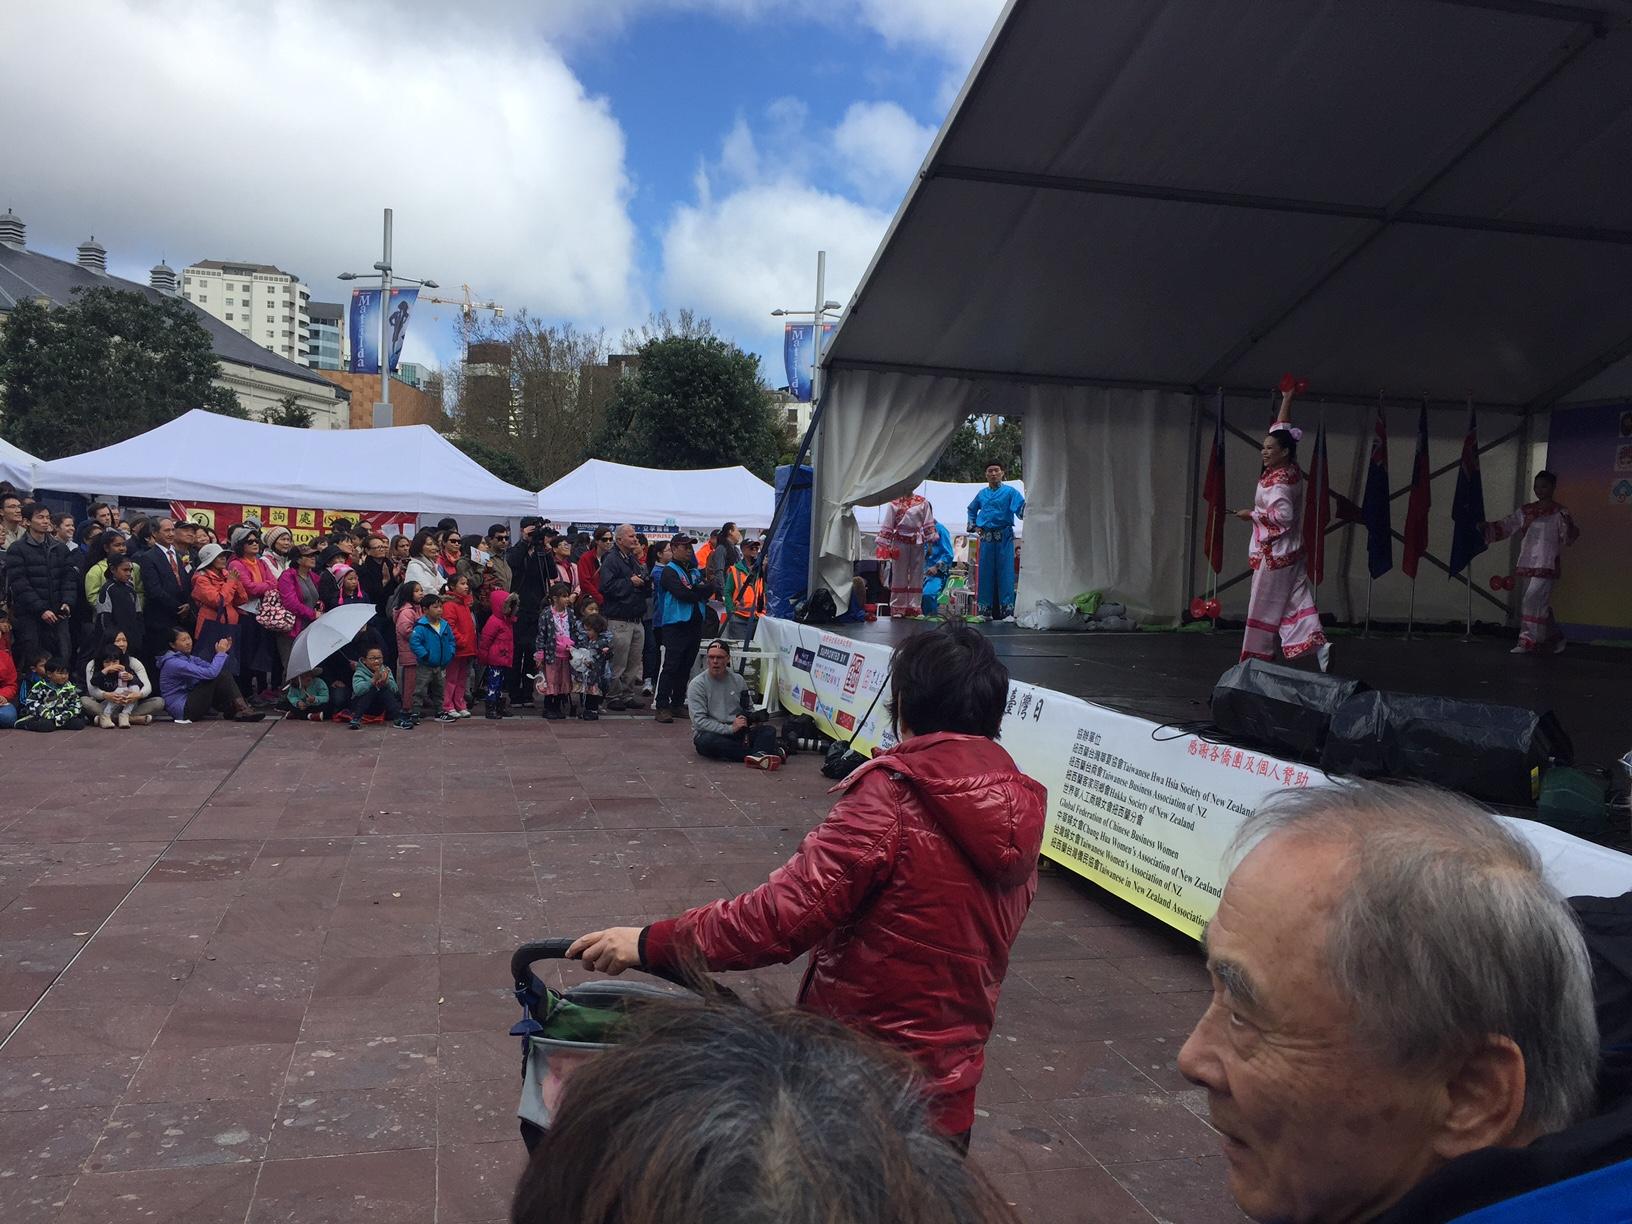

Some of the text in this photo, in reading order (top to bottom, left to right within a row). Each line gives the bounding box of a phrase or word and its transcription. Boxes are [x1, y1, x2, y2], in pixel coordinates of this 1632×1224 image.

[1128, 780, 1152, 797] Business
[1153, 790, 1186, 810] Association
[1187, 803, 1195, 813] of
[1196, 805, 1208, 819] NZ
[1128, 796, 1148, 813] Society
[1149, 805, 1157, 815] of
[1156, 806, 1168, 819] New
[1169, 812, 1195, 831] Zealand
[1151, 771, 1164, 785] Hwa
[1165, 777, 1179, 790] Hsia
[1180, 782, 1201, 801] Society
[1202, 791, 1211, 802] of
[1211, 793, 1225, 807] New
[1226, 799, 1256, 817] Zealand
[1060, 798, 1179, 859] Global Federation of Chinese Business Women
[1100, 831, 1111, 843] Hua
[1112, 836, 1136, 856] Women's
[1137, 850, 1171, 874] Association
[1172, 867, 1180, 876] of
[1179, 868, 1192, 883] New
[1194, 876, 1222, 898] Zealand
[1105, 850, 1129, 870] Women's
[1130, 864, 1163, 887] Association
[1164, 881, 1172, 891] of
[1171, 882, 1183, 897] NZ
[1125, 877, 1131, 888] in
[1131, 880, 1145, 894] New
[1146, 888, 1172, 909] Zealand
